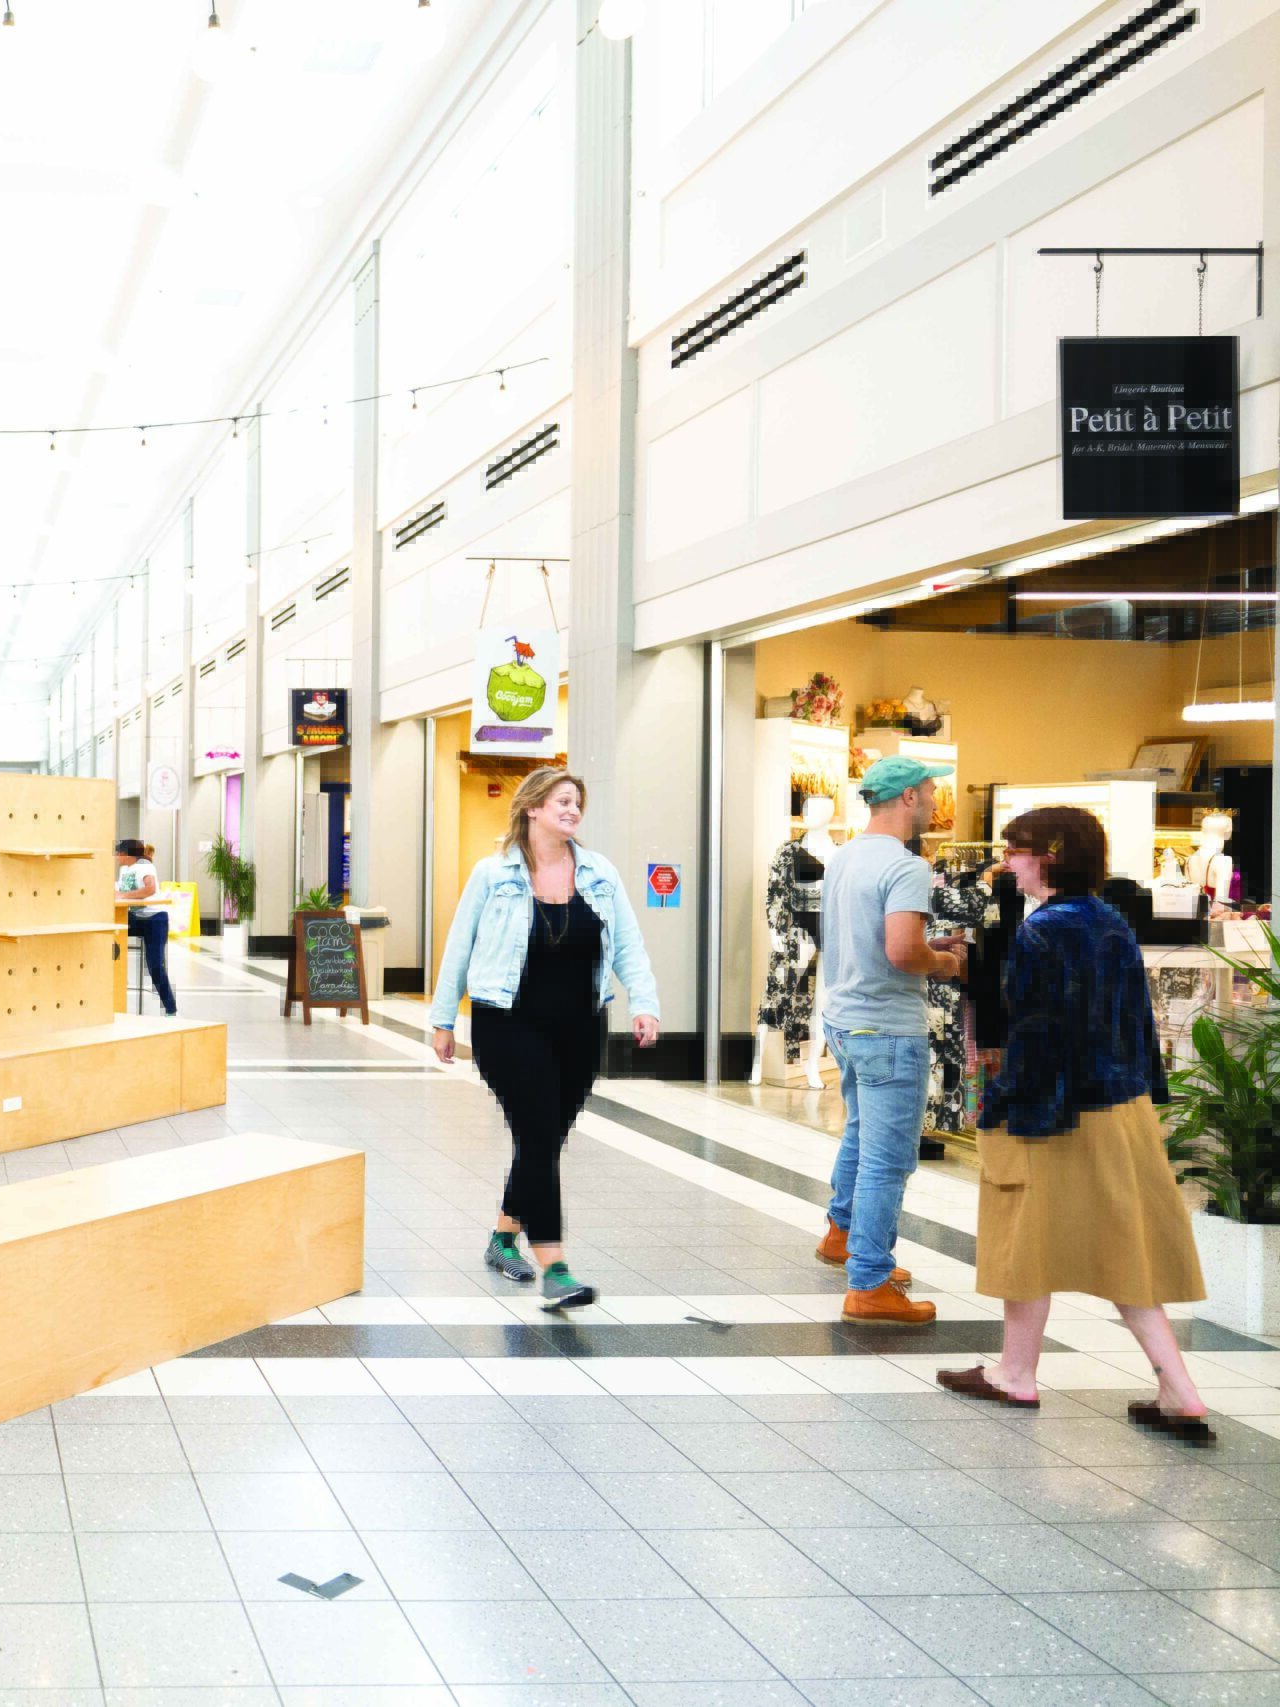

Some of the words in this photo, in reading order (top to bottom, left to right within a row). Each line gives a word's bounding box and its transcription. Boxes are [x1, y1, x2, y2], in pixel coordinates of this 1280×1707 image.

[1114, 385, 1148, 395] Lingerie
[1149, 384, 1185, 394] Boutique
[1069, 407, 1135, 433] Petit
[1143, 405, 1159, 431] à
[1168, 404, 1232, 431] Petit
[1072, 443, 1085, 454] for
[1107, 442, 1135, 452] Bridal,
[1137, 441, 1176, 452] Maternity
[1178, 441, 1185, 450] &
[1188, 440, 1230, 449] Menswear
